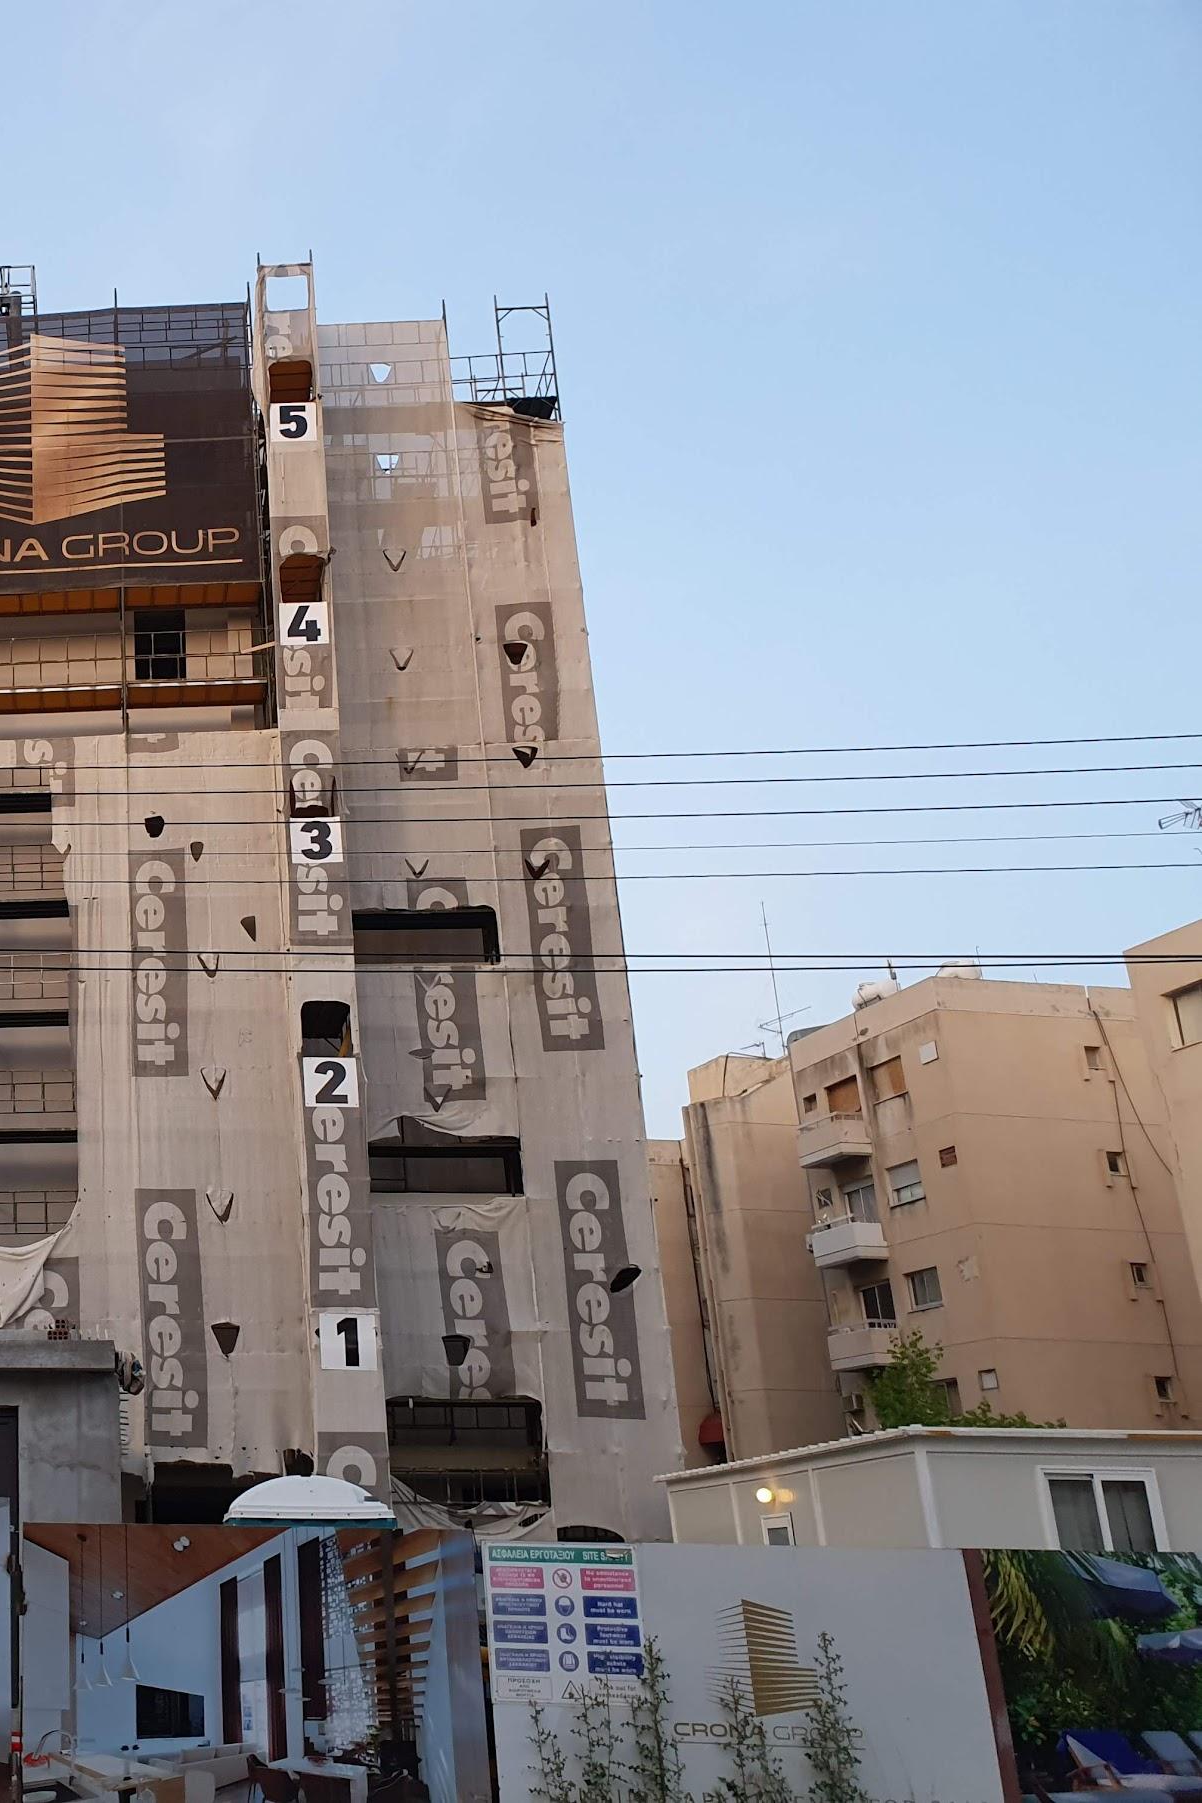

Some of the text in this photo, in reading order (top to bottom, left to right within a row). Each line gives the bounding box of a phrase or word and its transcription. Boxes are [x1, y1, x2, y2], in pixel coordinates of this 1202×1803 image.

[279, 405, 308, 439] 5
[61, 527, 240, 559] GROUP
[287, 605, 321, 642] 4
[300, 821, 334, 860] 3
[530, 837, 592, 1039] Ceresit
[135, 860, 180, 1065] Ceresit
[314, 1061, 349, 1104] 2
[565, 1173, 632, 1406] Ceresit
[143, 1201, 199, 1436] Ceresit
[336, 1317, 360, 1367] 1
[582, 1551, 599, 1561] SITE
